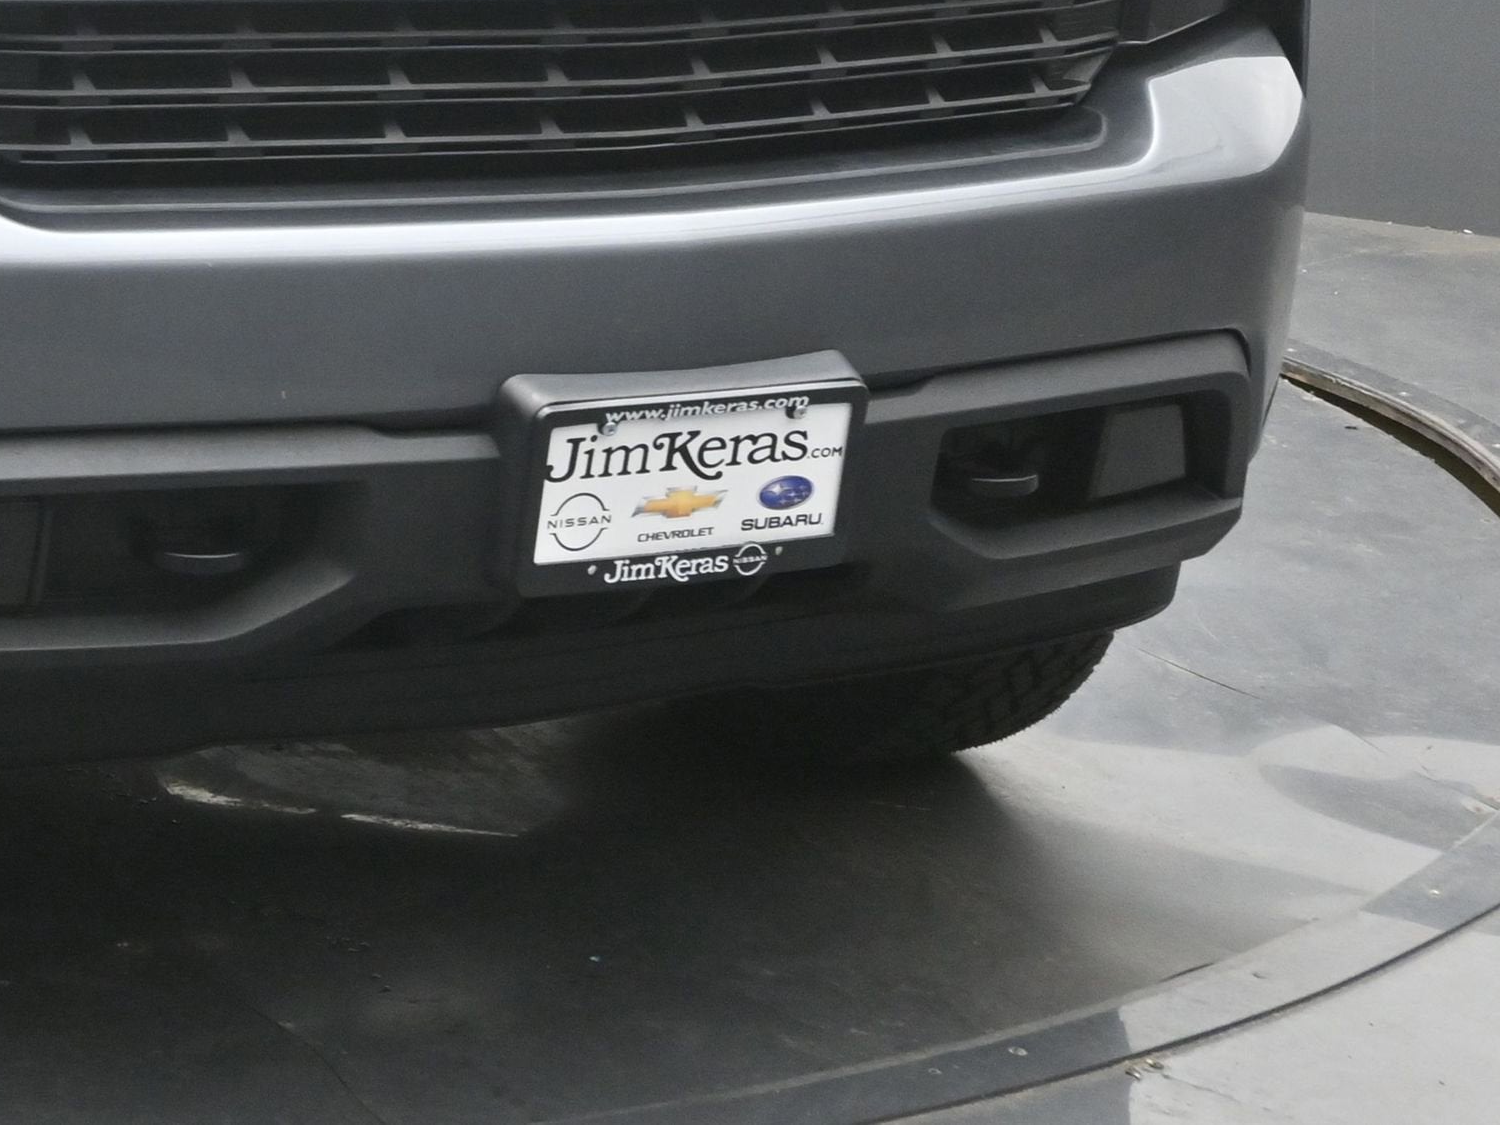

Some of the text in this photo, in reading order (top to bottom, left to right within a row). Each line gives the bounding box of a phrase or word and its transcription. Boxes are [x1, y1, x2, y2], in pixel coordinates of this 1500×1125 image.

[605, 394, 810, 422] www.jimkeras.com
[547, 513, 612, 530] NISSAN
[740, 512, 822, 531] SUBARU
[637, 526, 715, 543] CHEVROLET
[603, 552, 768, 584] JimKeras NISSAN
